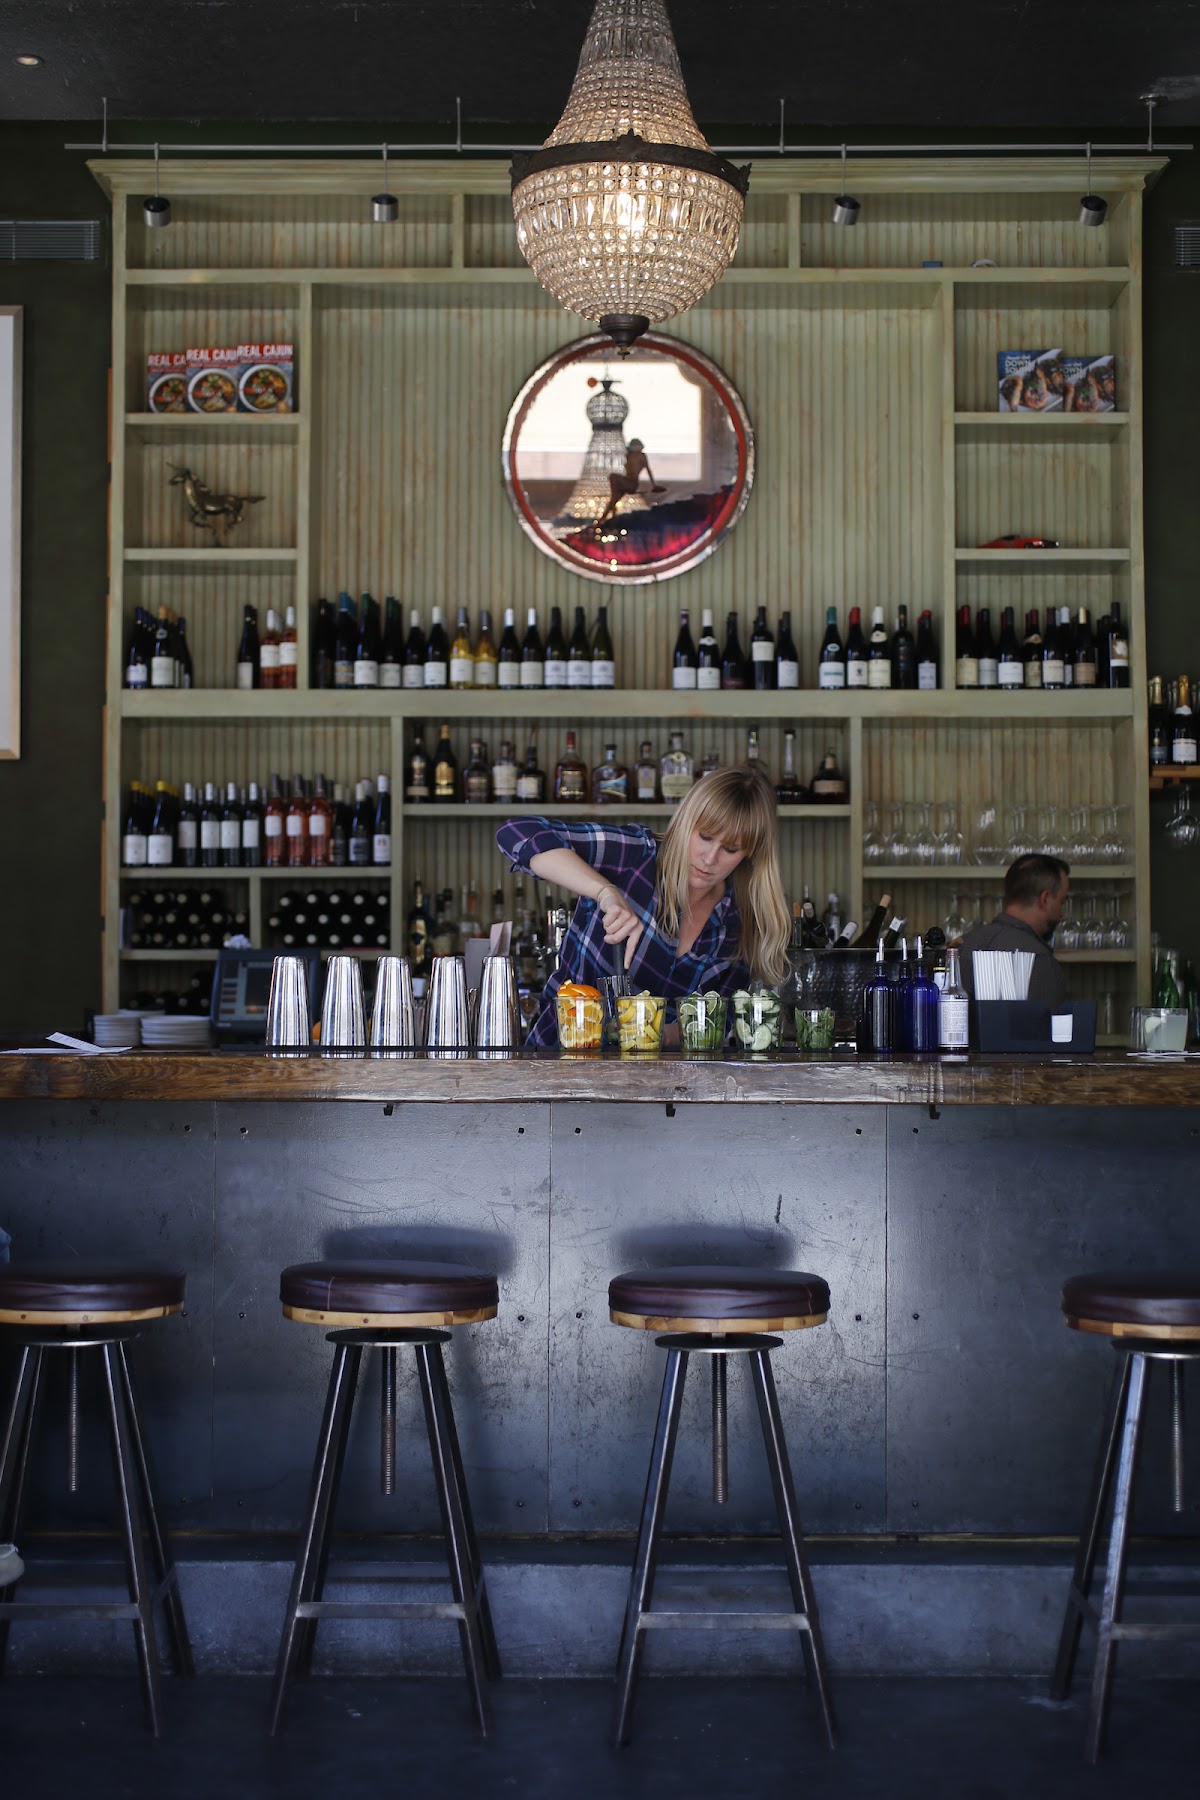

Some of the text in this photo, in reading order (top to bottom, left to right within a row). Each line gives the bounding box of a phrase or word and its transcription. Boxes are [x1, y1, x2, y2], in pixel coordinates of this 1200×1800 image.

[186, 348, 211, 361] REAL
[212, 348, 237, 361] CAJU
[237, 344, 293, 357] REAL CAJUN
[147, 354, 173, 367] REAL
